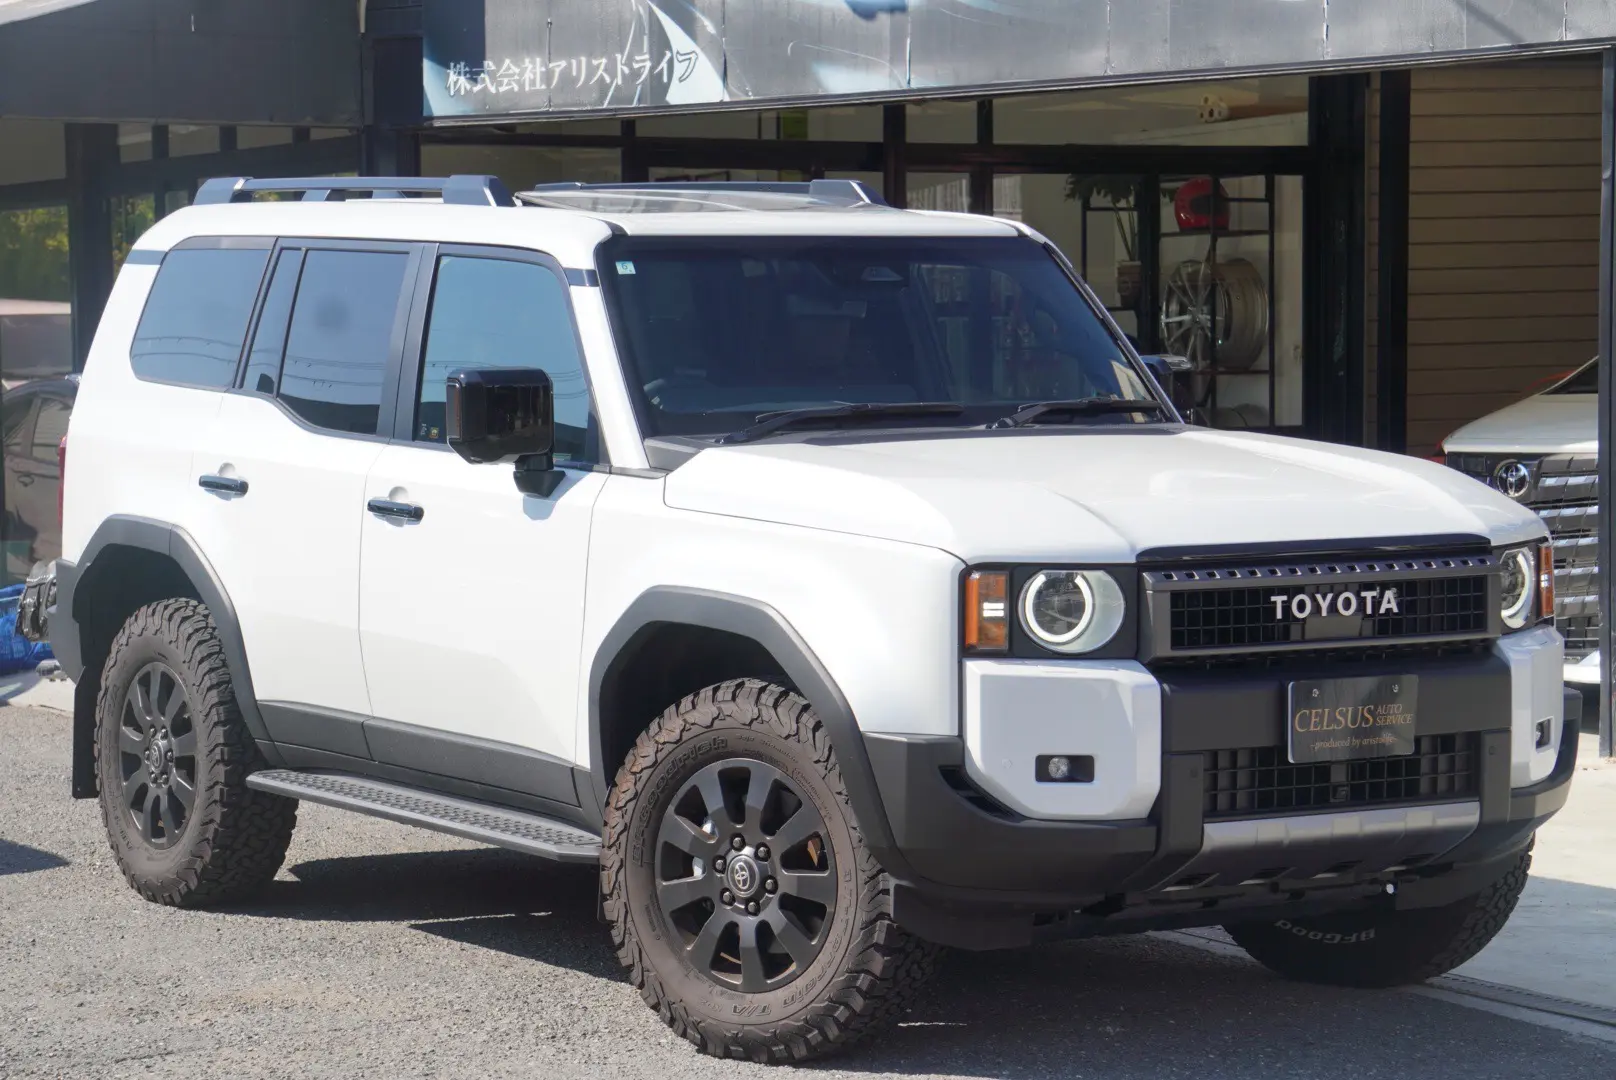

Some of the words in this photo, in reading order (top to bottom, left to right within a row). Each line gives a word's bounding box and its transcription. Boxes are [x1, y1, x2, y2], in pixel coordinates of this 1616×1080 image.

[446, 49, 698, 97] 株式会社アリストライフ
[1270, 589, 1399, 620] TOYOTA
[1294, 704, 1375, 733] CELSUS
[1375, 713, 1413, 726] SERVICE
[1376, 703, 1403, 716] AUTO
[1352, 736, 1361, 749] by
[632, 736, 728, 868] BFGoodrich
